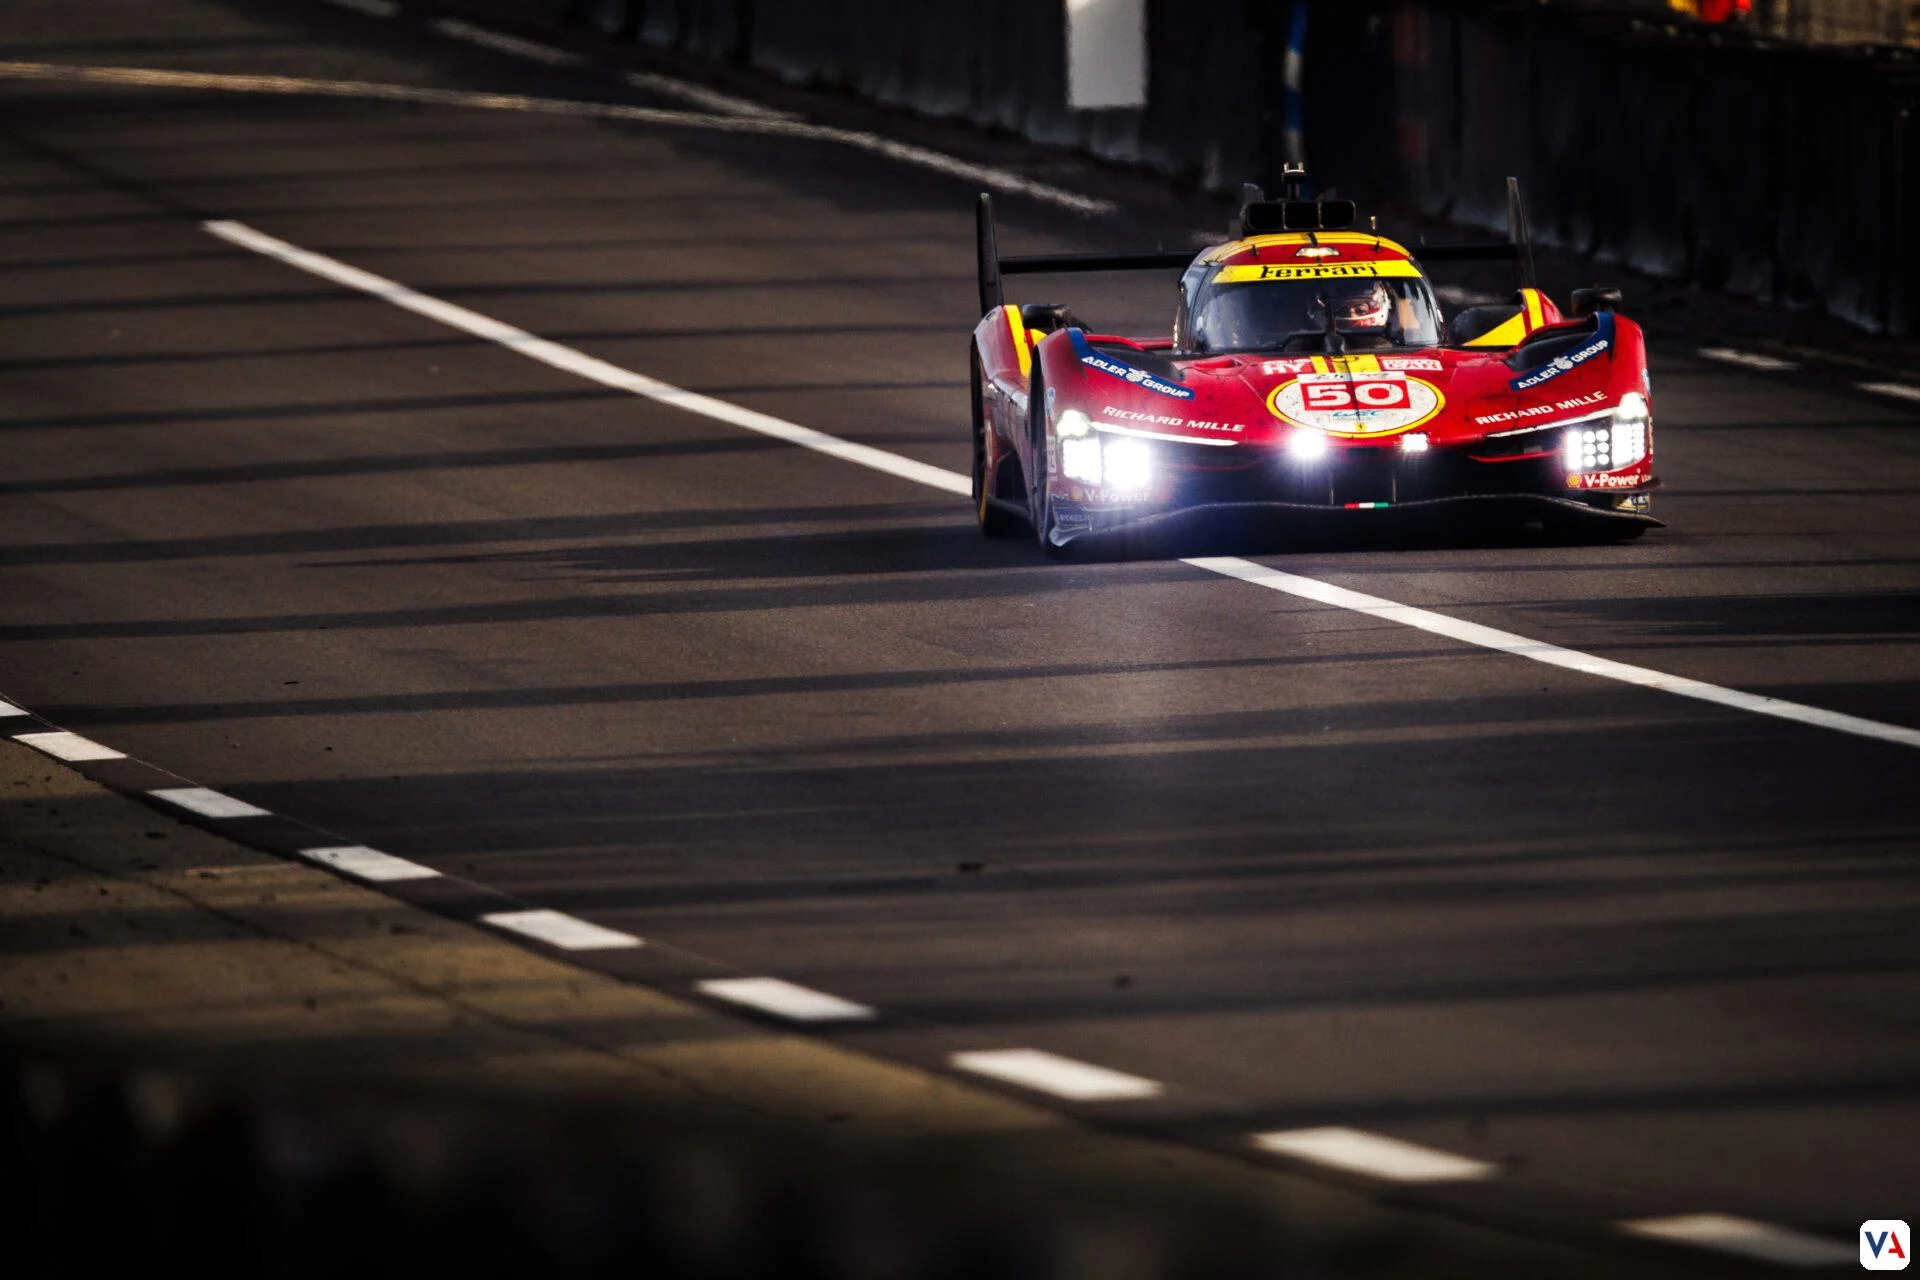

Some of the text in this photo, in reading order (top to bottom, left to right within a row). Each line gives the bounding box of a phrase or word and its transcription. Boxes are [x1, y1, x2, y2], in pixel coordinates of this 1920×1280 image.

[1259, 262, 1378, 279] Ferrari
[1081, 356, 1190, 398] ADLER GROUP
[1517, 340, 1608, 390] ADLER GROUP
[1307, 383, 1404, 407] 50
[1474, 391, 1608, 425] RICHARD MILLE
[1102, 406, 1246, 433] RICHARD MILLE
[1584, 473, 1639, 488] V-Power
